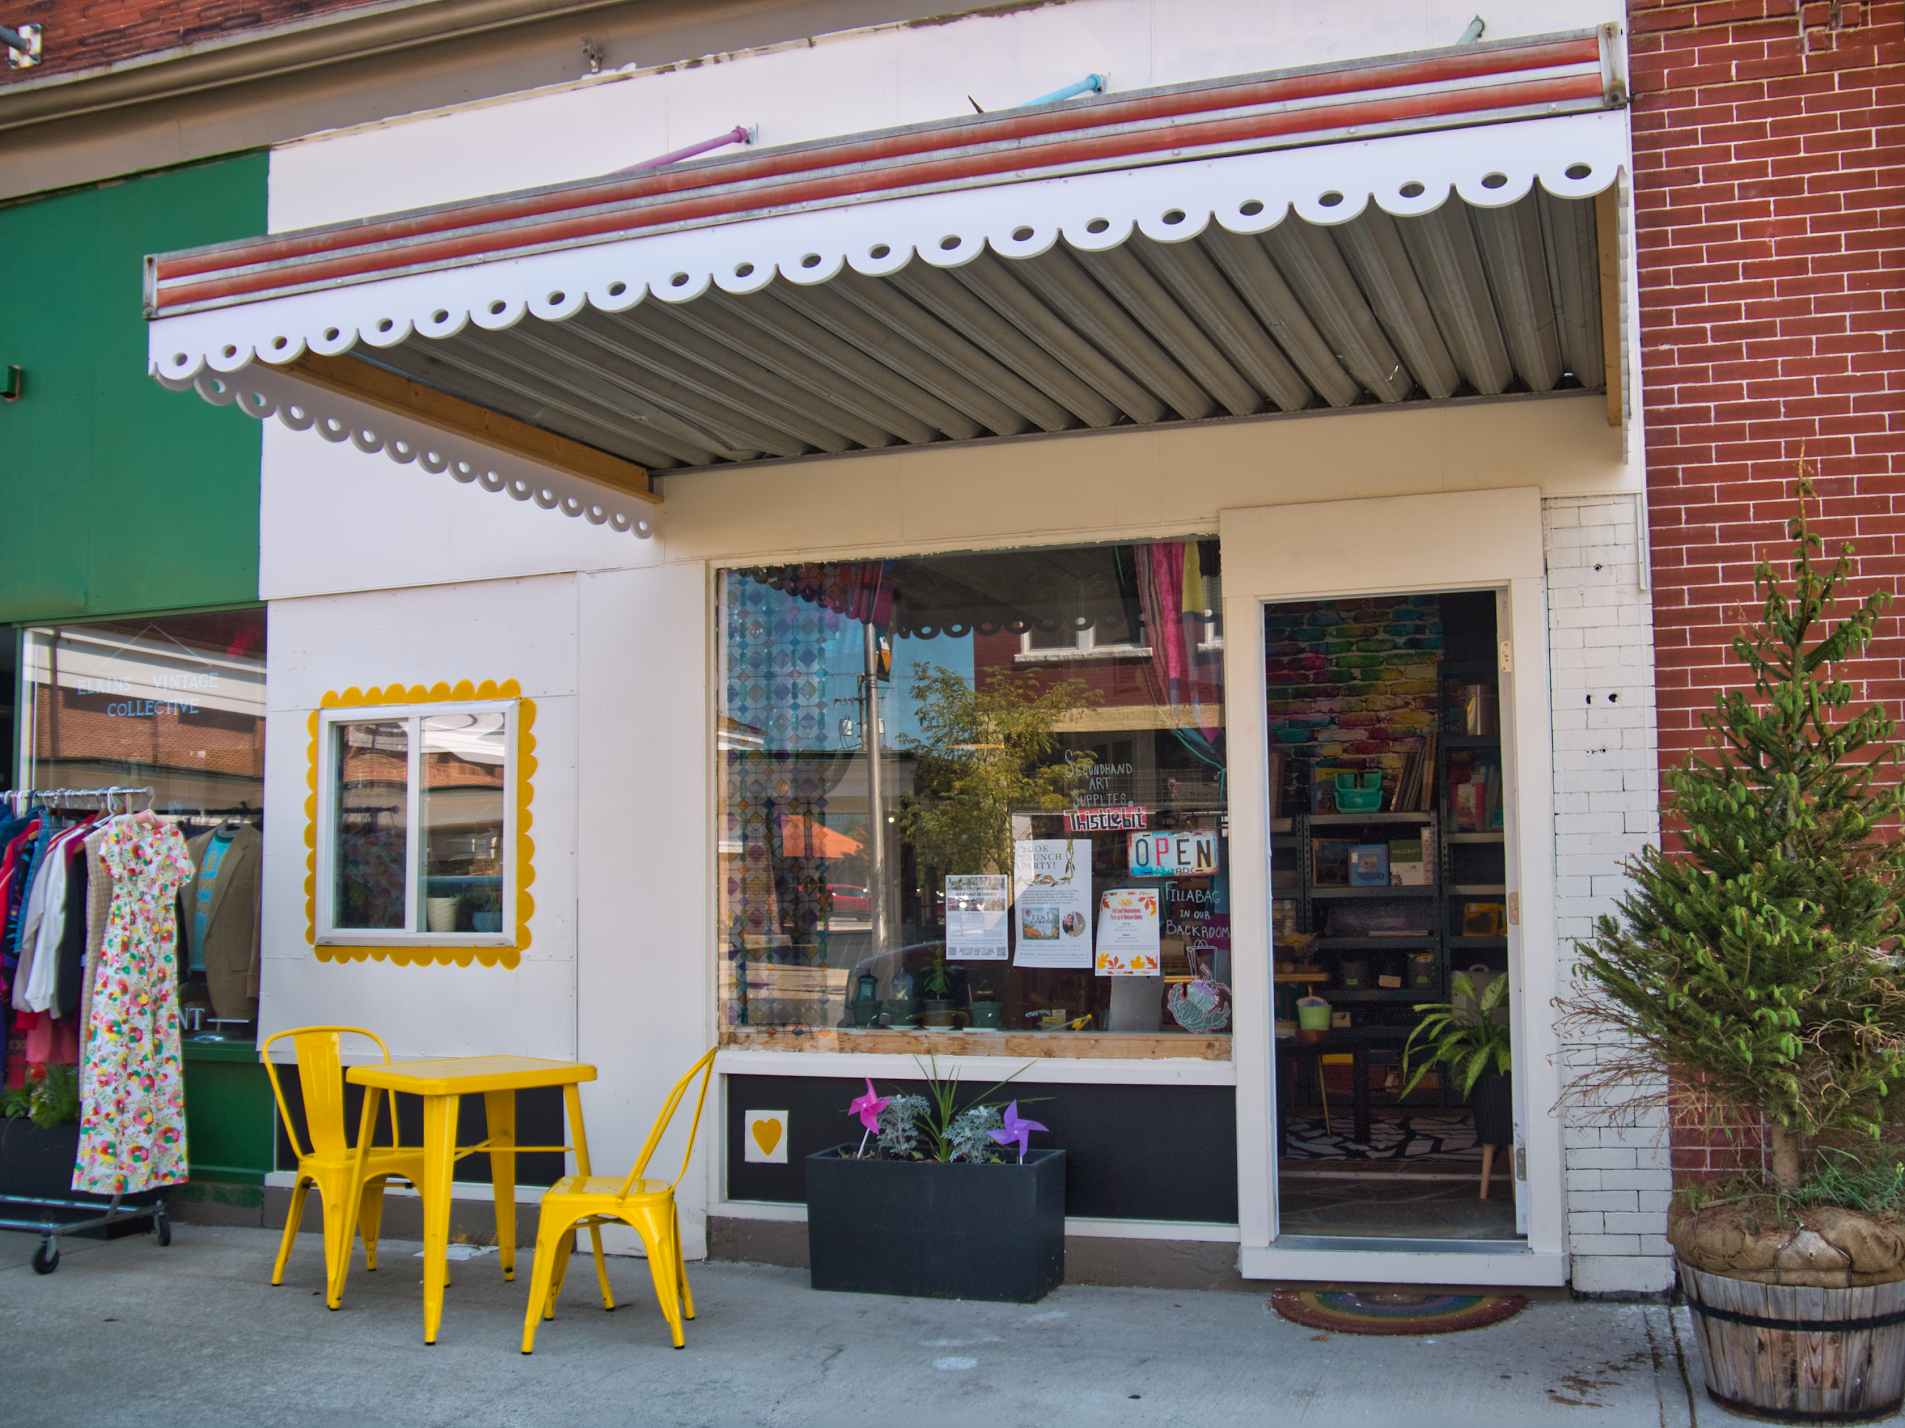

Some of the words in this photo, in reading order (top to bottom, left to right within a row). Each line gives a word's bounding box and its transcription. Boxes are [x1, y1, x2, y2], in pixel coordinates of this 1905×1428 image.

[77, 677, 131, 695] ELKINS
[152, 673, 219, 690] VINTAGE
[107, 698, 200, 717] COLLECTIVE
[1088, 777, 1111, 790] ART
[1021, 845, 1049, 853] BOOK
[1135, 837, 1212, 868] OPEN
[1021, 853, 1062, 861] LAUNCH
[1021, 861, 1056, 870] PARTY!
[1180, 909, 1190, 918] IN
[1193, 909, 1211, 920] OUR
